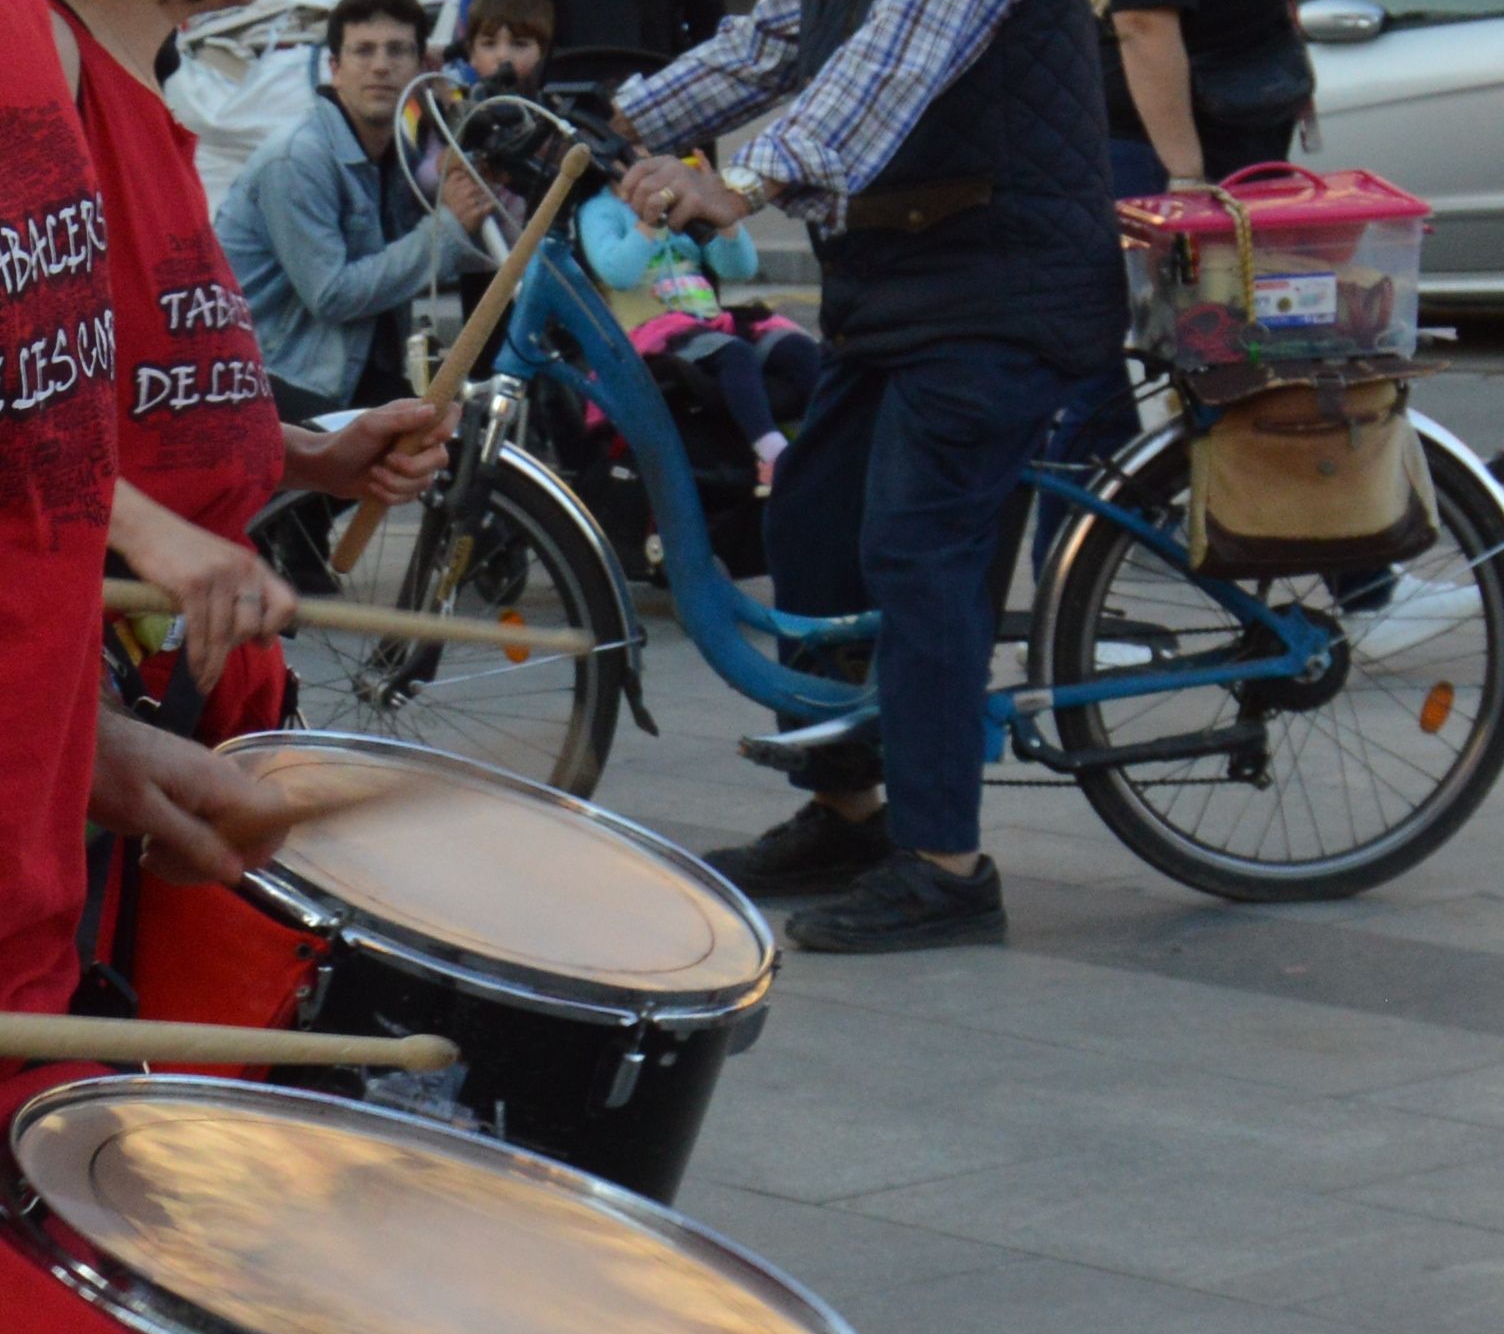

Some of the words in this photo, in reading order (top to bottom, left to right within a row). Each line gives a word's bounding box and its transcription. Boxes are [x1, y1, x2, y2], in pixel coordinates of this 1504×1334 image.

[12, 334, 77, 410] LES
[134, 362, 197, 415] DE
[204, 360, 258, 405] LES
